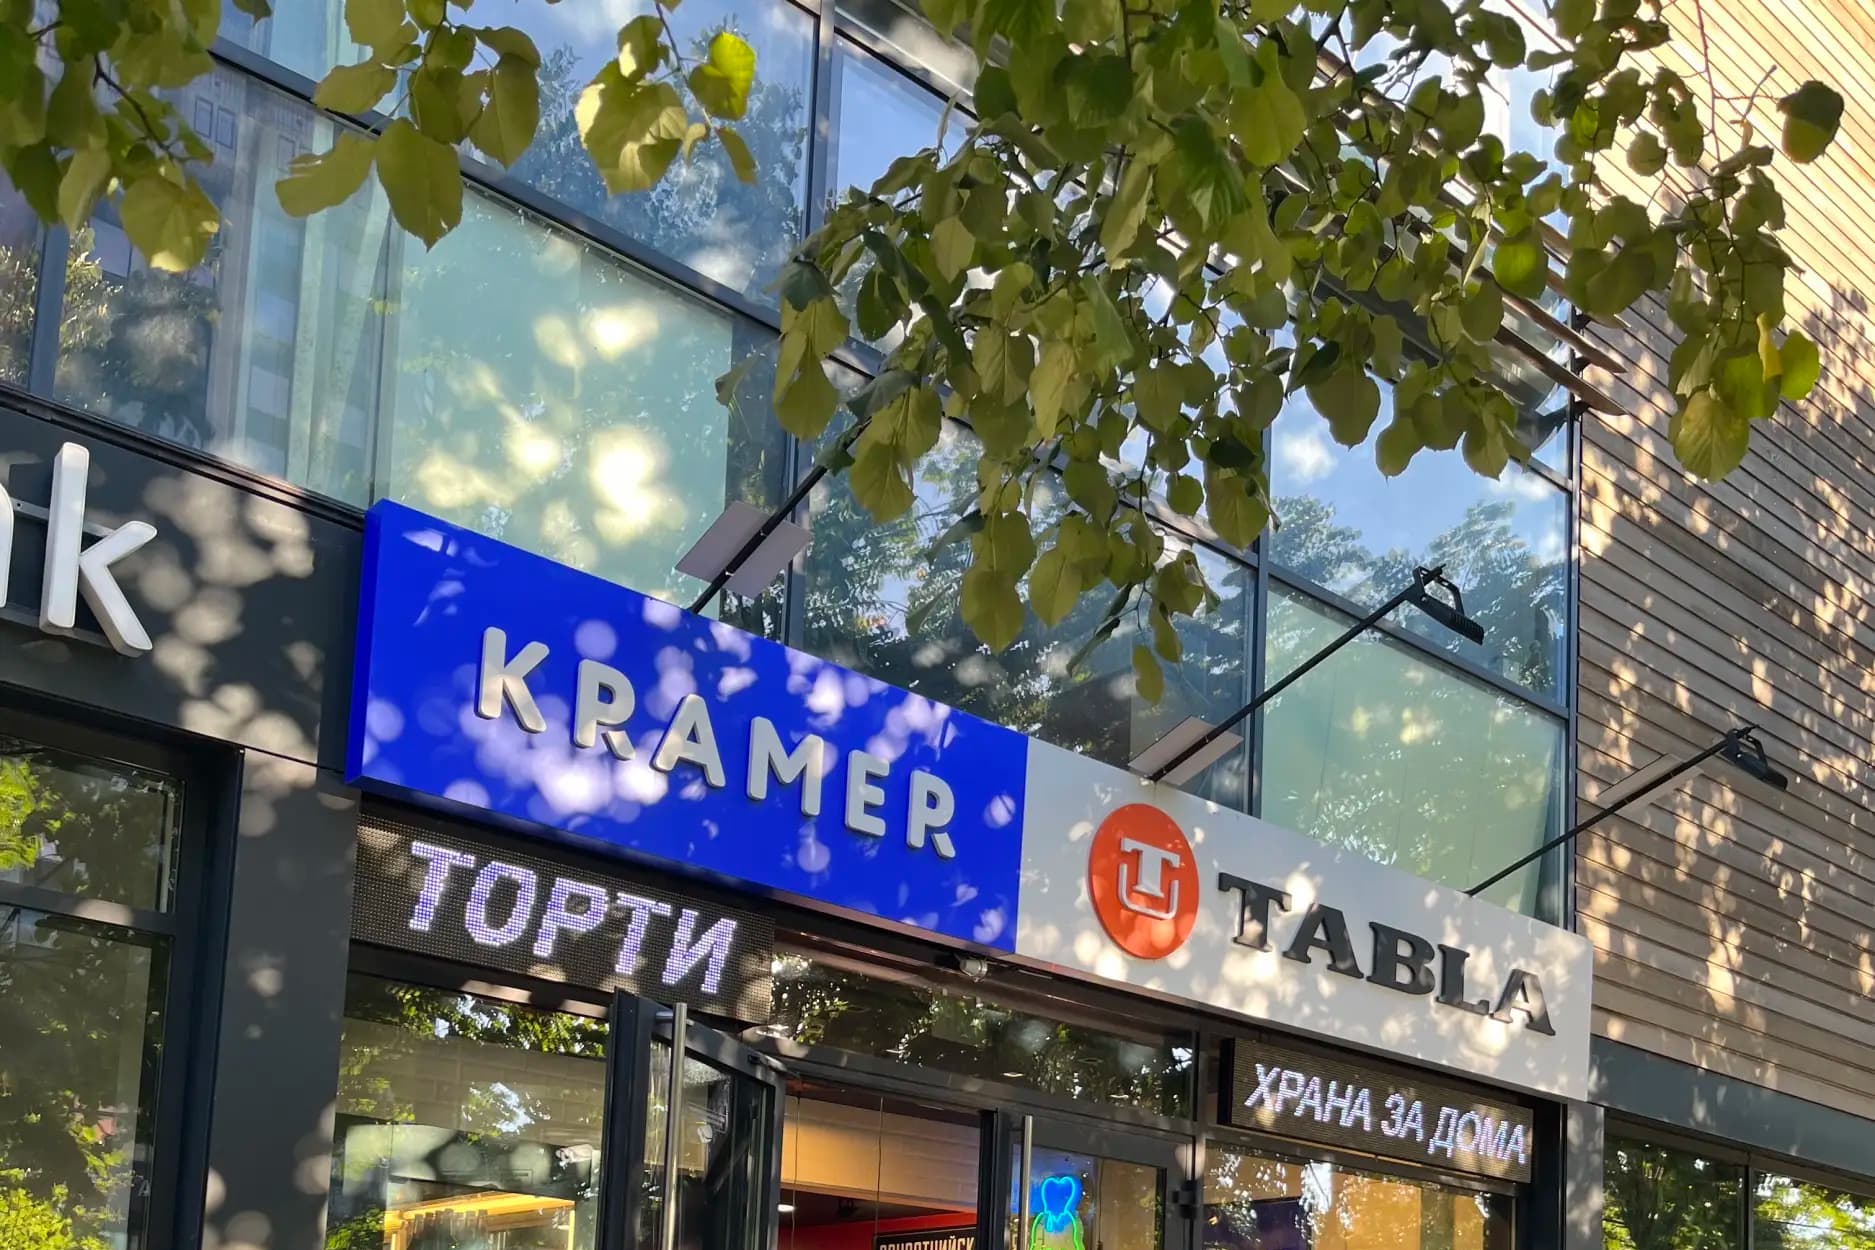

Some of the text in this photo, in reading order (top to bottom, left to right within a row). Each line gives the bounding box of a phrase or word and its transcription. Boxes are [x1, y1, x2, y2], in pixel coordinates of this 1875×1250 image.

[0, 441, 158, 657] k
[475, 626, 957, 859] KRAMER
[410, 842, 738, 995] ТОРТИ
[1218, 872, 1556, 1036] TABLA
[1244, 1064, 1526, 1165] ХРАНА ЗА ДОМА
